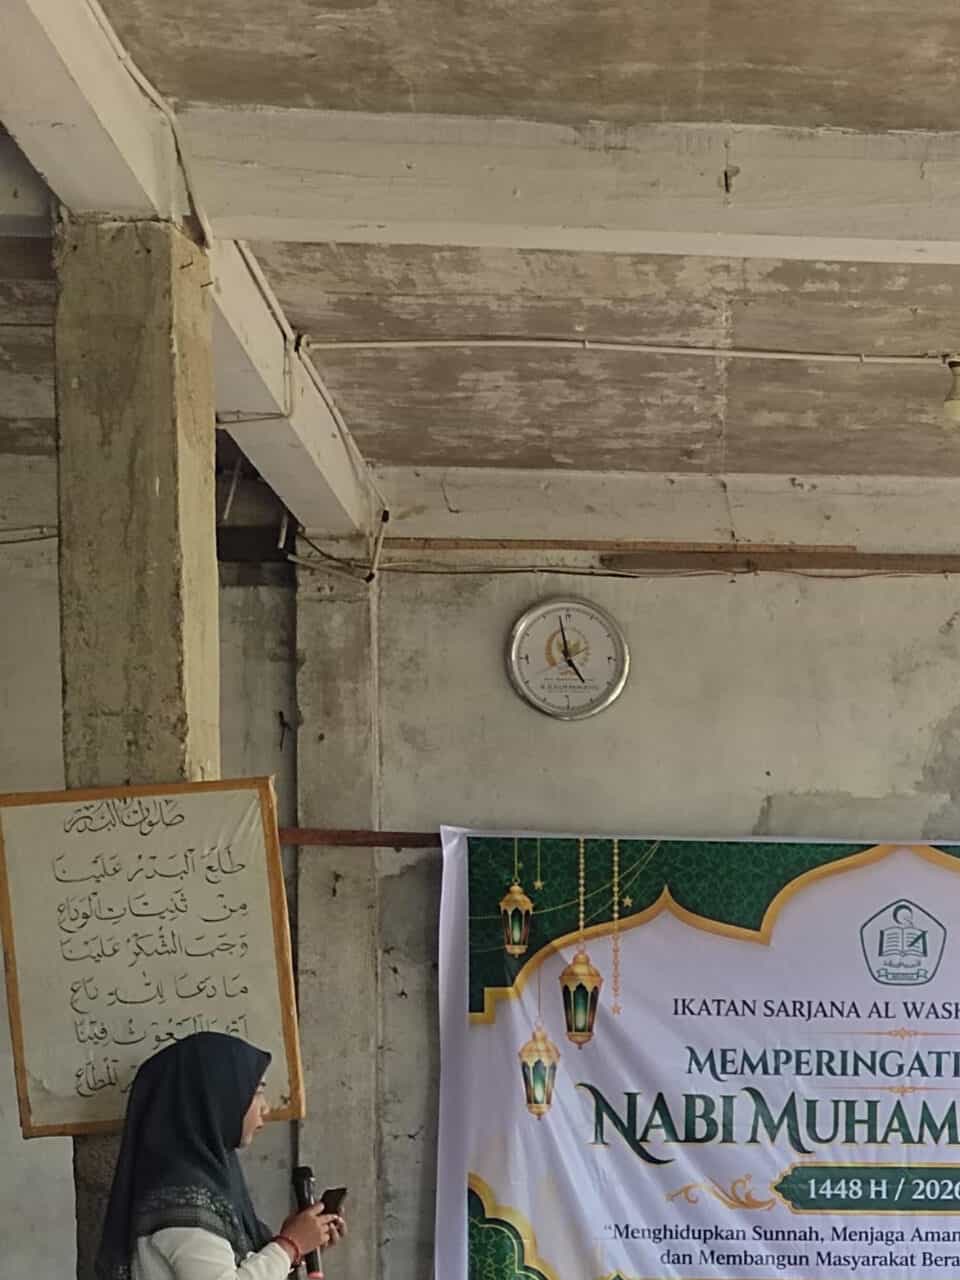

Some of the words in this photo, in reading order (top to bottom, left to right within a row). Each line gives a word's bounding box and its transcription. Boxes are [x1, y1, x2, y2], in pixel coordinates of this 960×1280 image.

[673, 997, 757, 1017] IKATAN
[763, 999, 861, 1021] SARJANA
[867, 1001, 896, 1019] AL
[685, 1045, 960, 1082] MEMPERINGATI
[575, 1082, 738, 1164] NABI
[807, 1179, 862, 1199] 1448
[869, 1179, 888, 1199] H
[894, 1178, 904, 1201] /
[752, 1226, 824, 1243] Sunnah,
[831, 1226, 905, 1245] Menjaga
[660, 1249, 693, 1265] dan
[699, 1250, 810, 1269] Membangun
[815, 1251, 915, 1270] Masyarakat
